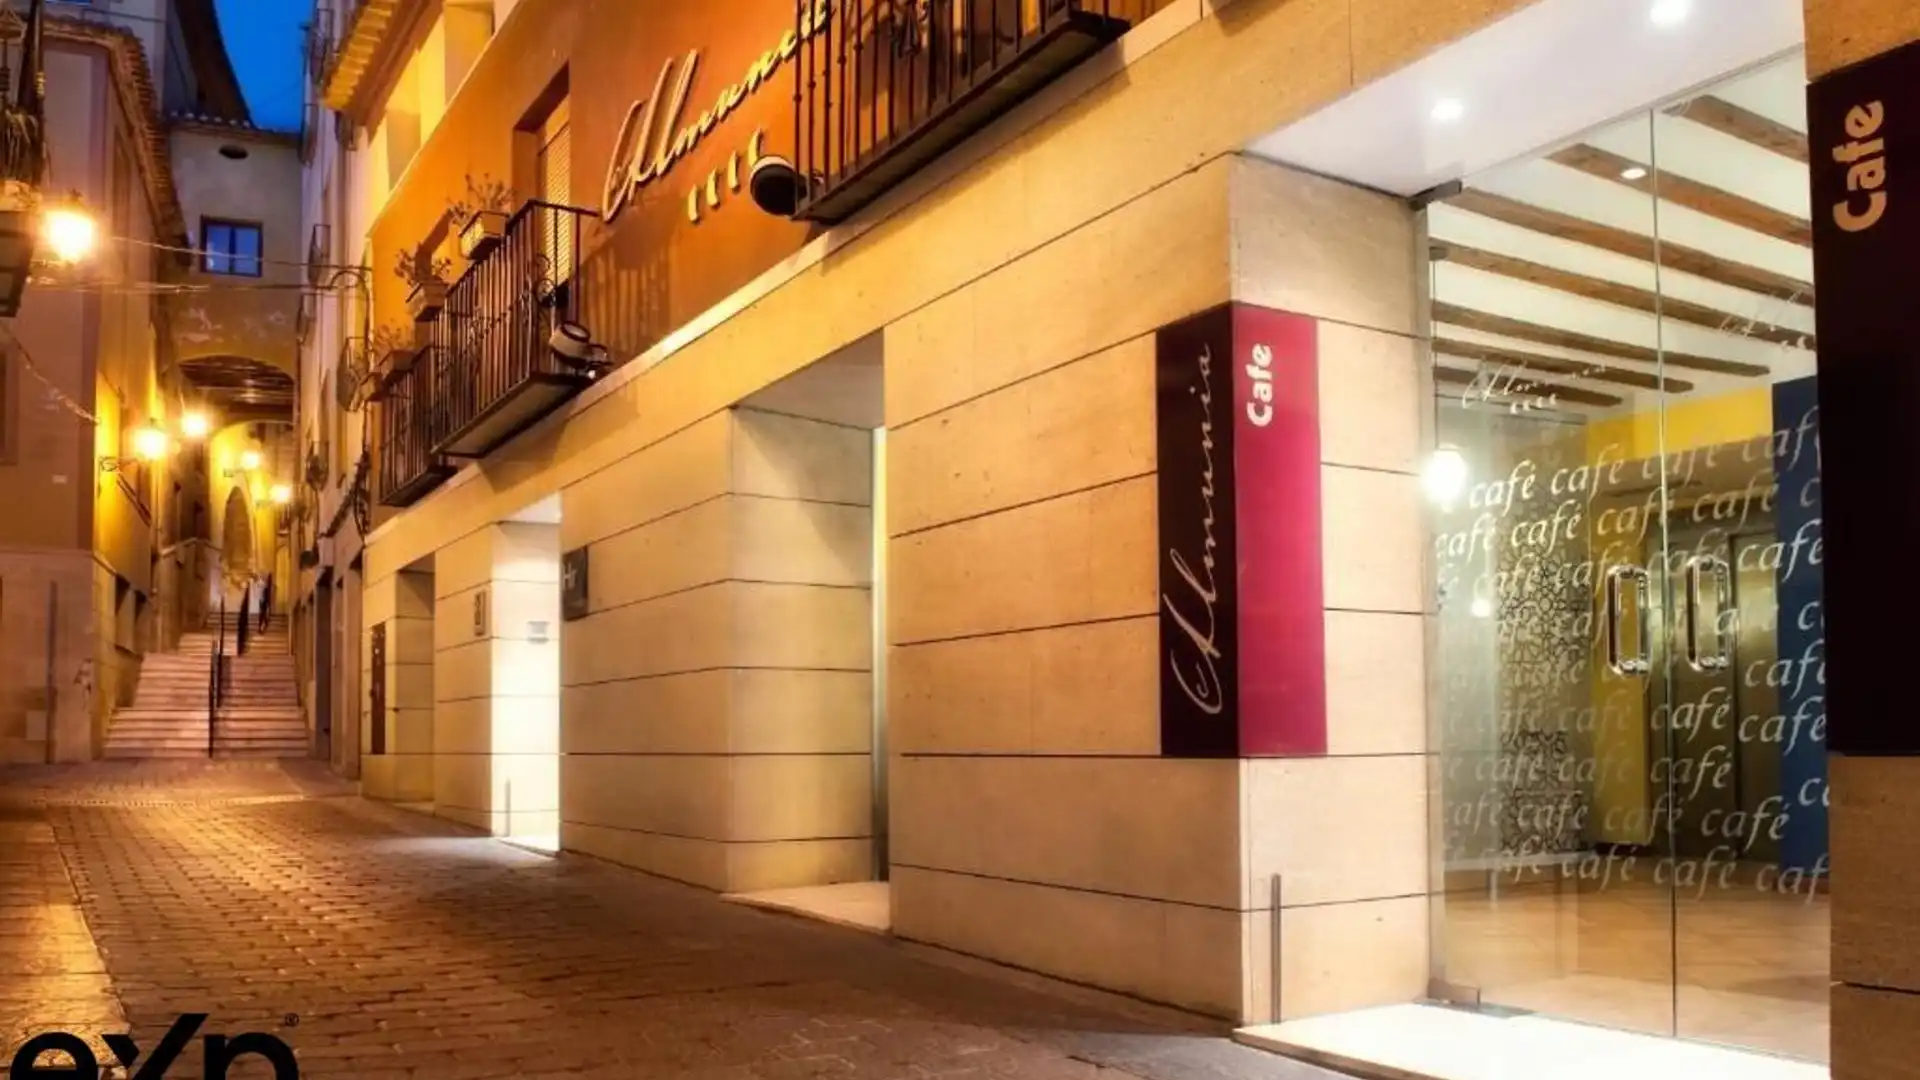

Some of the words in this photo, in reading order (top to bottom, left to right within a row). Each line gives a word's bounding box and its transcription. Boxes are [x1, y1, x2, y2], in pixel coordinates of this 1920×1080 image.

[1163, 343, 1223, 715] Almunia
[1700, 795, 1793, 853] café
[1755, 851, 1830, 907] caf
